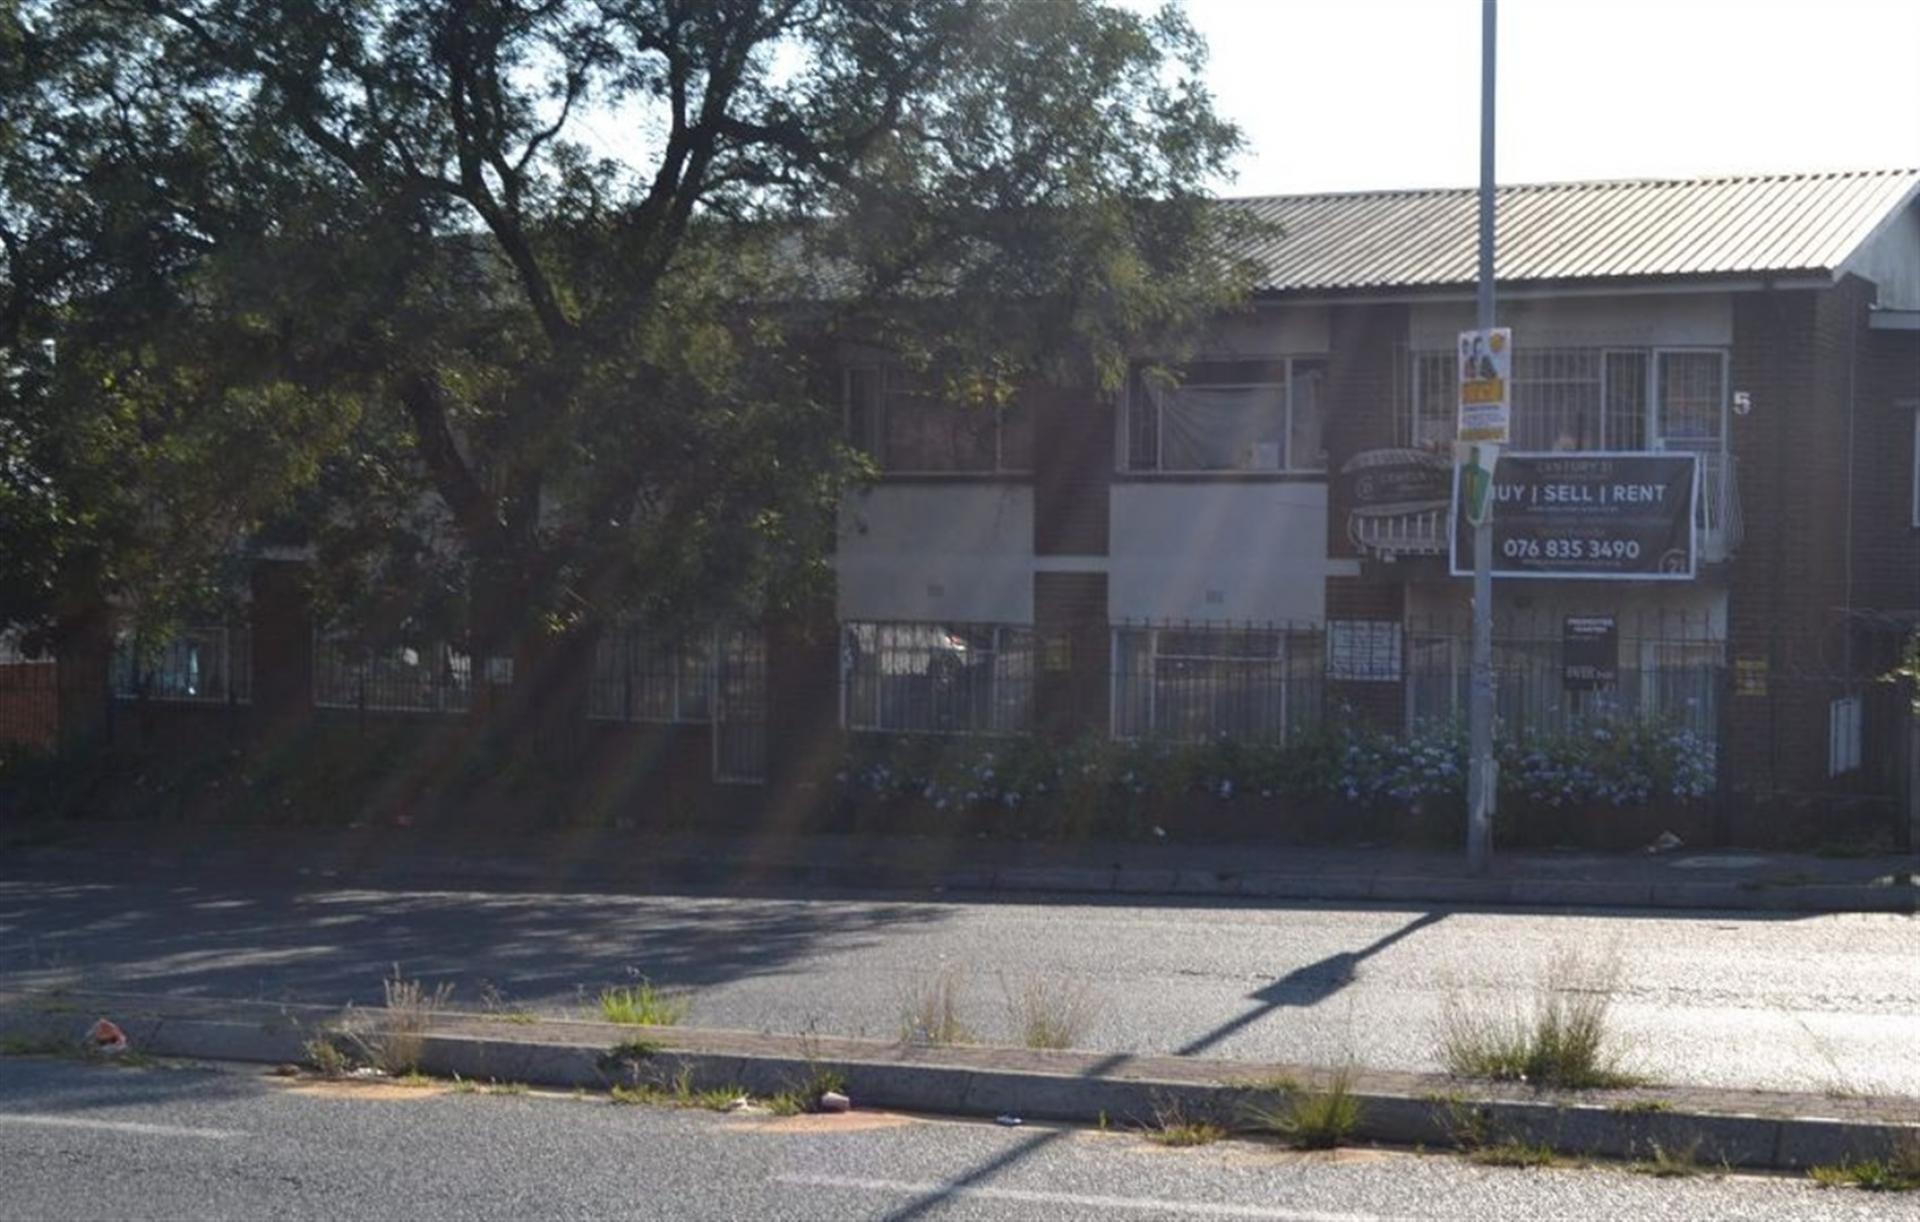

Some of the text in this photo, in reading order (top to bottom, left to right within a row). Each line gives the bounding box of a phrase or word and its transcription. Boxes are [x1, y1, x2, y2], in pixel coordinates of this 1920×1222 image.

[1734, 391, 1751, 415] 5
[1544, 484, 1593, 502] SELL
[1614, 484, 1667, 502] RENT
[1503, 538, 1640, 559] 076 835 3490
